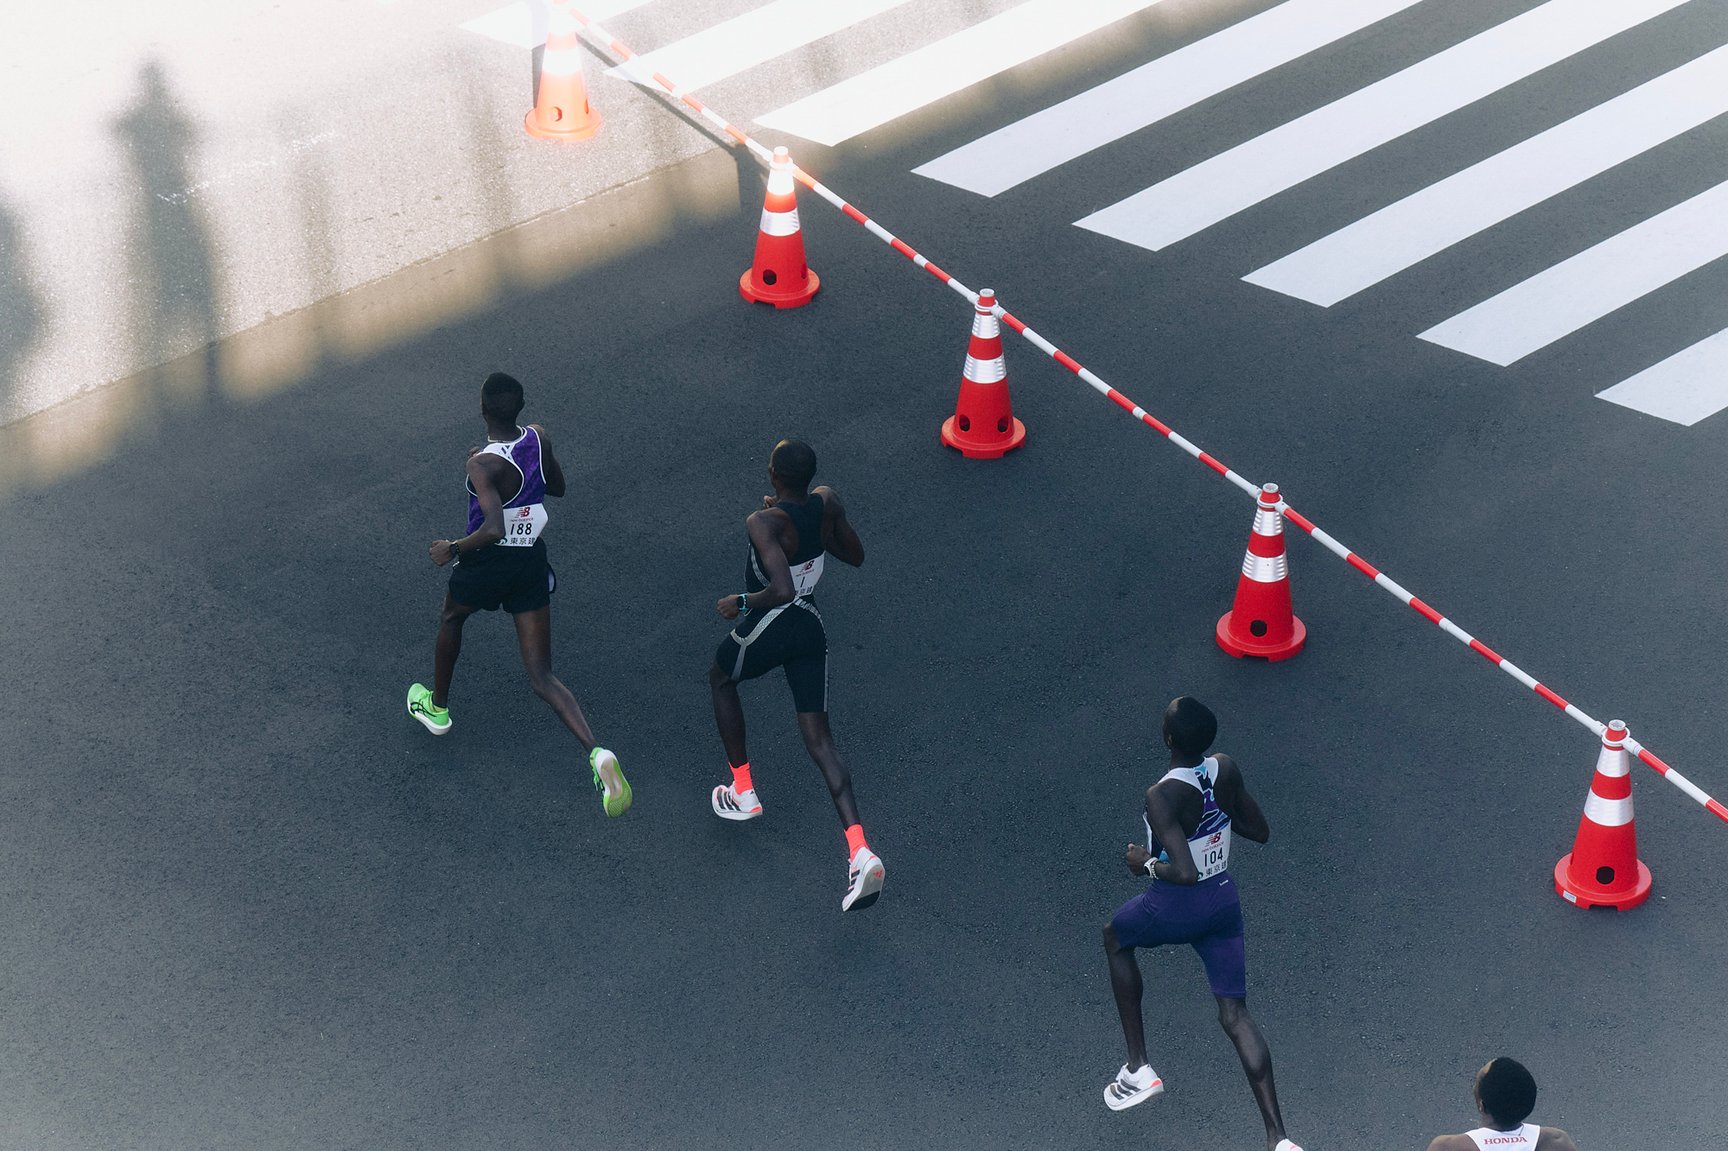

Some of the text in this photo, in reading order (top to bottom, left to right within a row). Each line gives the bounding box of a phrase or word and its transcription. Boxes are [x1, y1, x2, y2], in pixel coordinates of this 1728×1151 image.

[510, 523, 532, 535] 188
[1204, 847, 1223, 867] 104
[1484, 1136, 1528, 1145] HONDA
